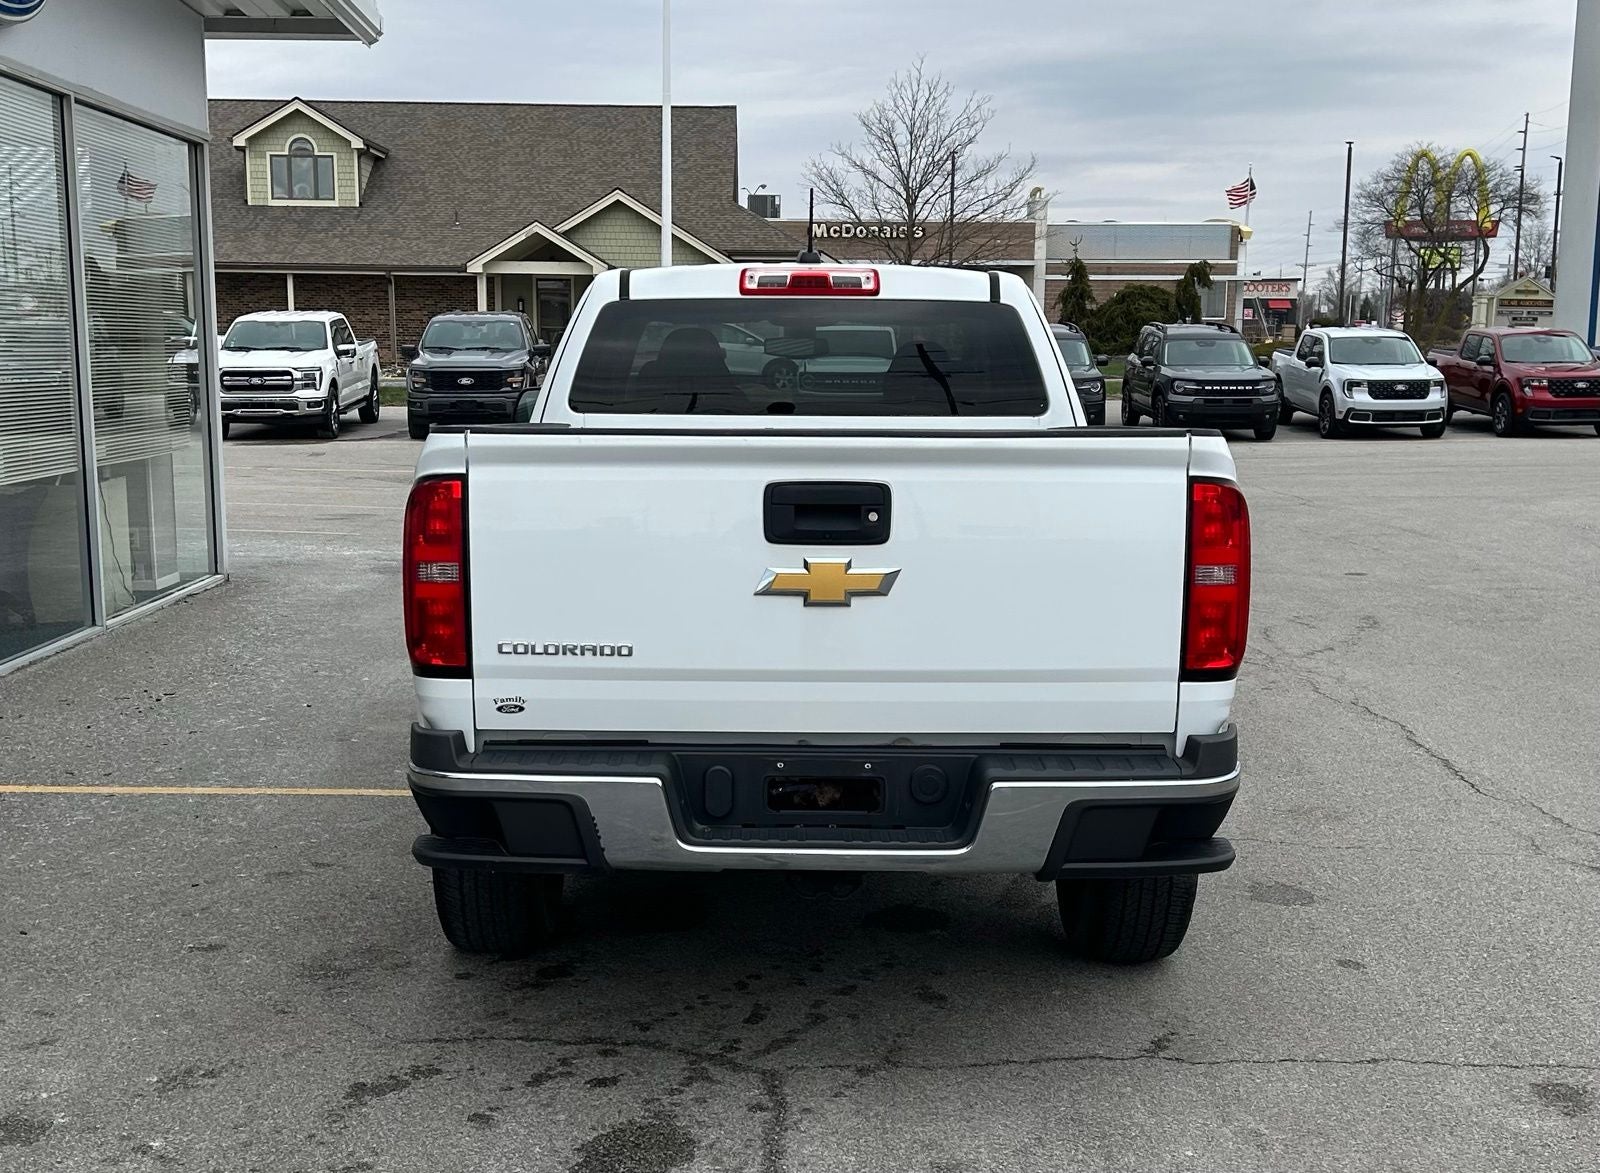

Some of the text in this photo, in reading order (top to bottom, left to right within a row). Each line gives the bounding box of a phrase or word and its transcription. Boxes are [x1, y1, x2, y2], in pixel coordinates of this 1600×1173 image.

[812, 223, 924, 238] McDonalds
[497, 641, 633, 657] COLORADO
[493, 696, 527, 705] Family
[500, 704, 521, 713] Ford
